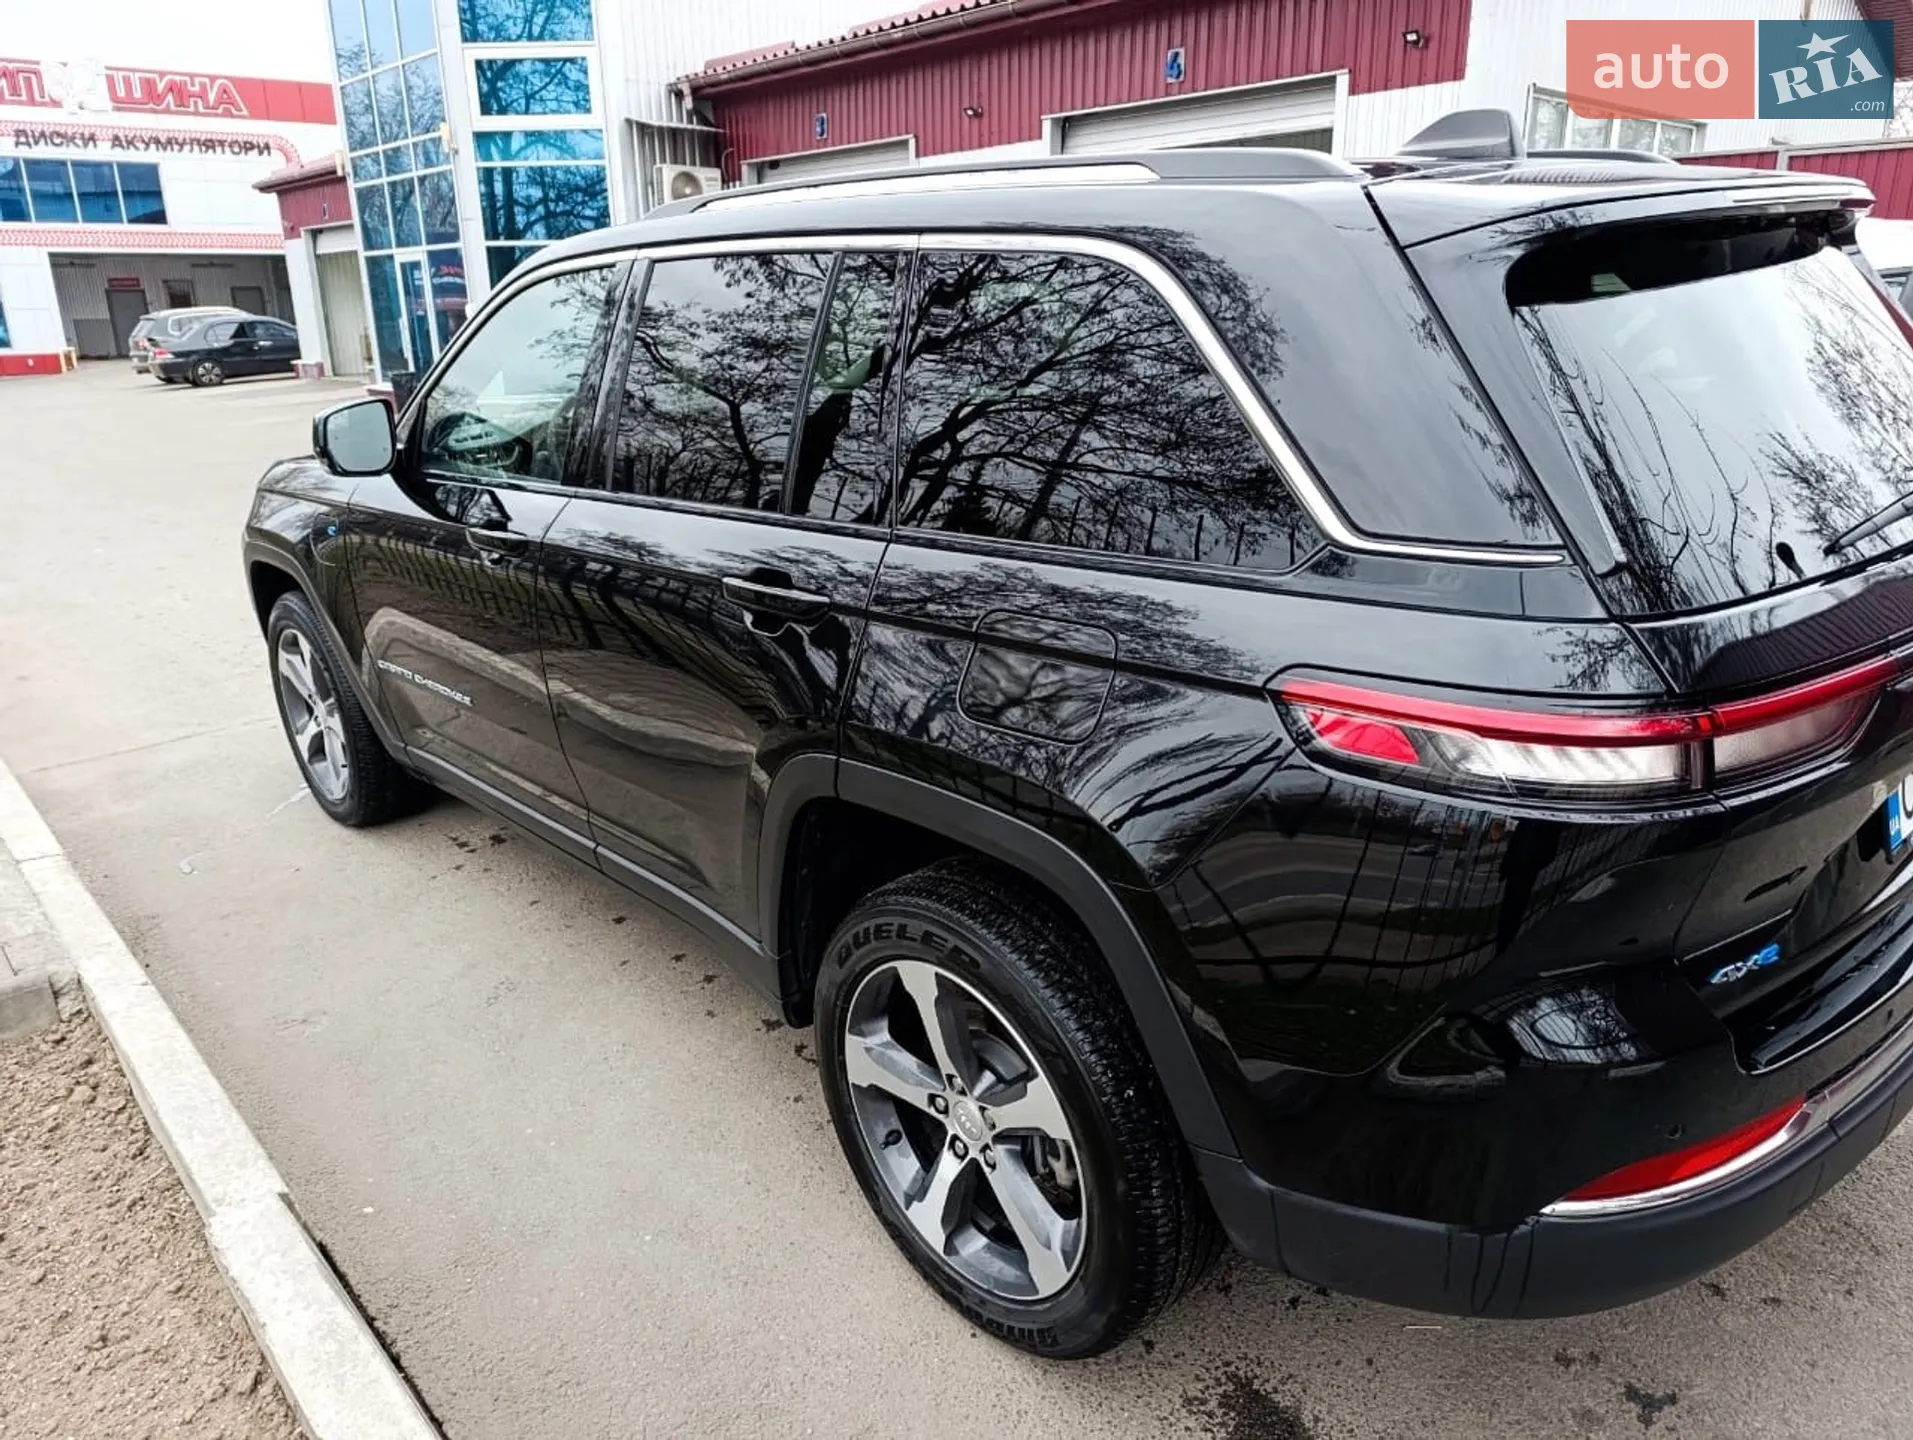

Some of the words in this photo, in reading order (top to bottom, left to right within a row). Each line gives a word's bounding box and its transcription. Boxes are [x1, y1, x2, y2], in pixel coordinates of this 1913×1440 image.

[103, 70, 249, 116] ШИНА
[14, 128, 98, 150] ДИСКИ
[110, 133, 272, 157] АКУМУЛЯТОРИ
